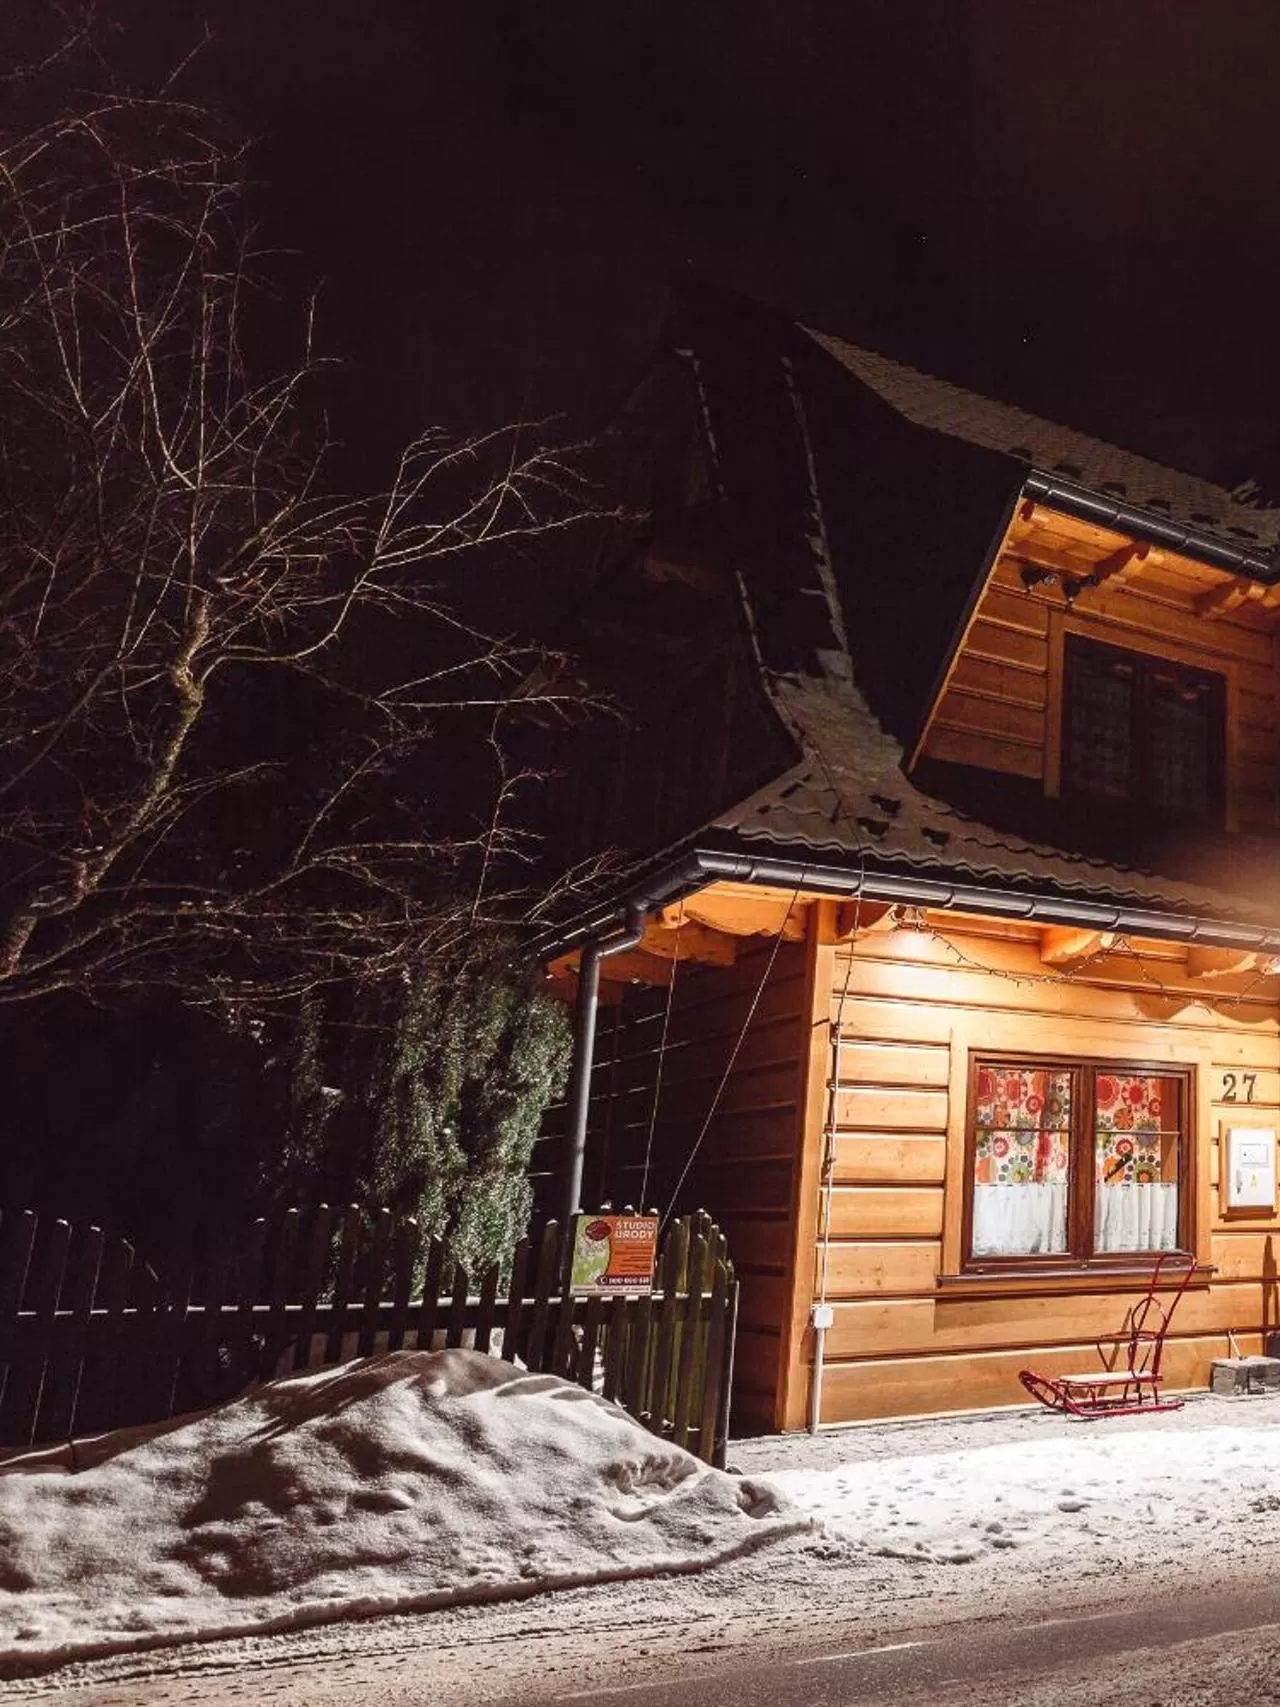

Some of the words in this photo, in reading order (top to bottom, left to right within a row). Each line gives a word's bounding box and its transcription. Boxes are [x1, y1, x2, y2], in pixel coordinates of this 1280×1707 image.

[1221, 1073, 1257, 1103] 27
[616, 1220, 655, 1230] STUDIO
[615, 1230, 654, 1239] URODY
